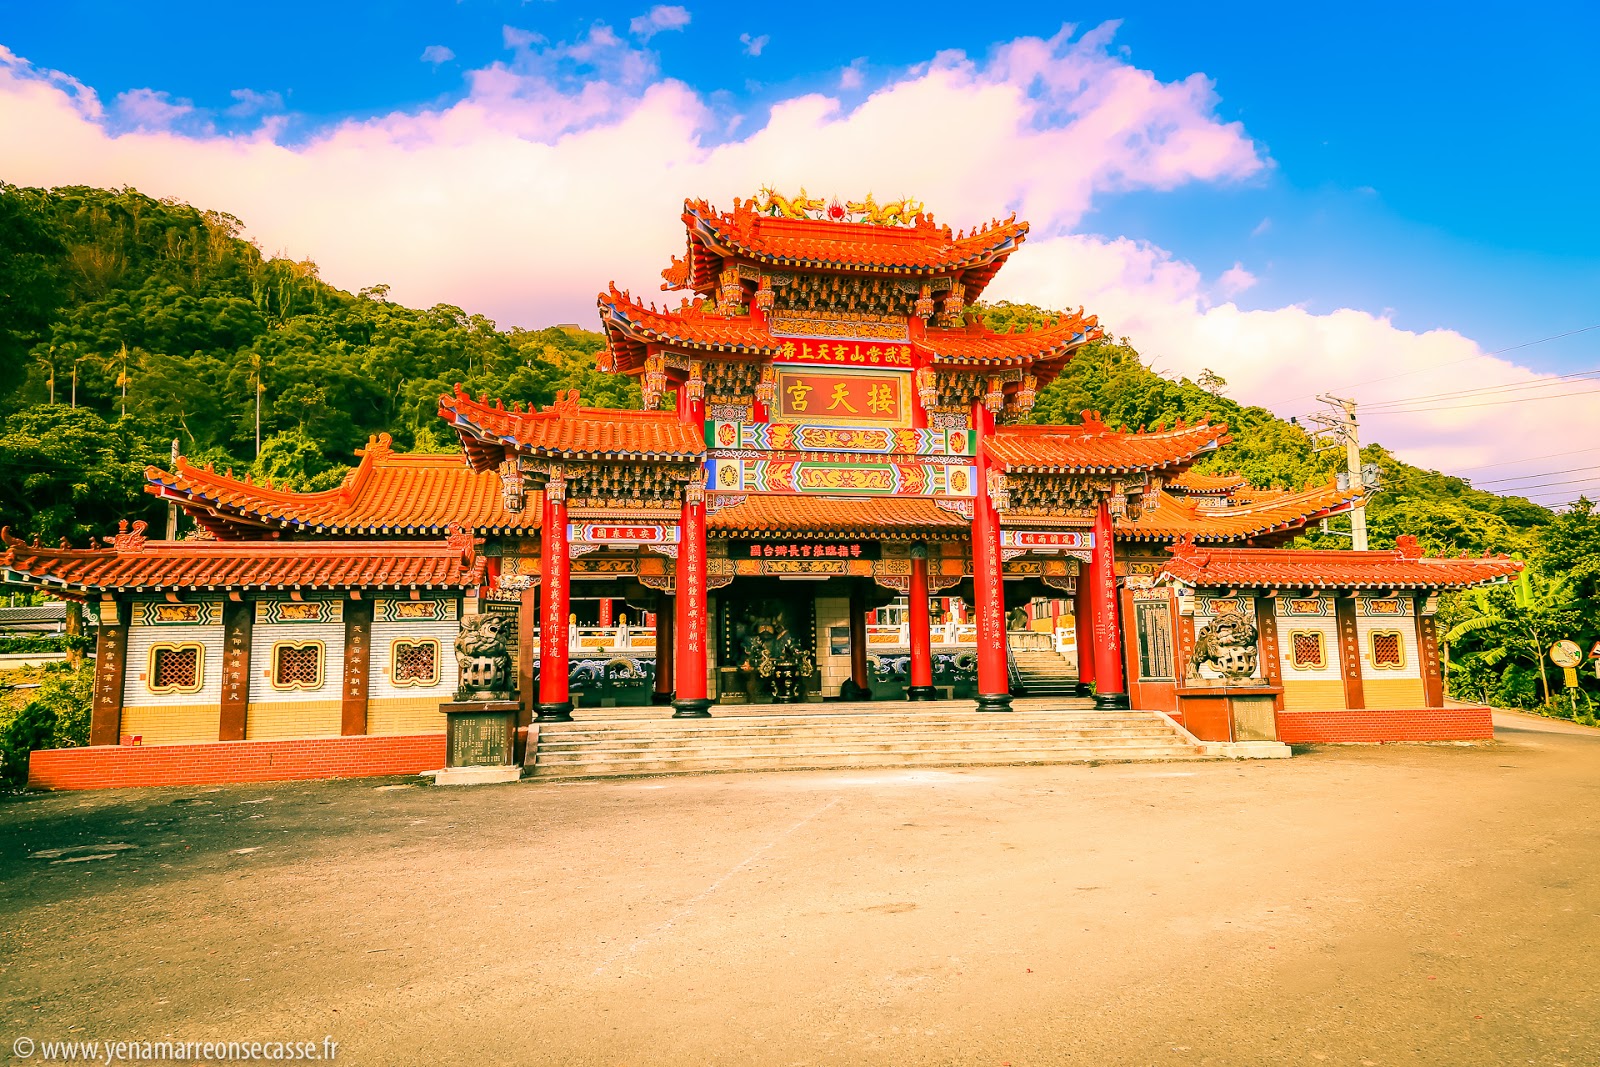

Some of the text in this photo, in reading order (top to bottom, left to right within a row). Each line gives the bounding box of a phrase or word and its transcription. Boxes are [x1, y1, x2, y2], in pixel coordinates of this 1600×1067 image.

[596, 528, 651, 539] 國泰民安
[1025, 534, 1071, 545] 風調雨順
[749, 544, 863, 558] 國台辦長官蒞臨指導
